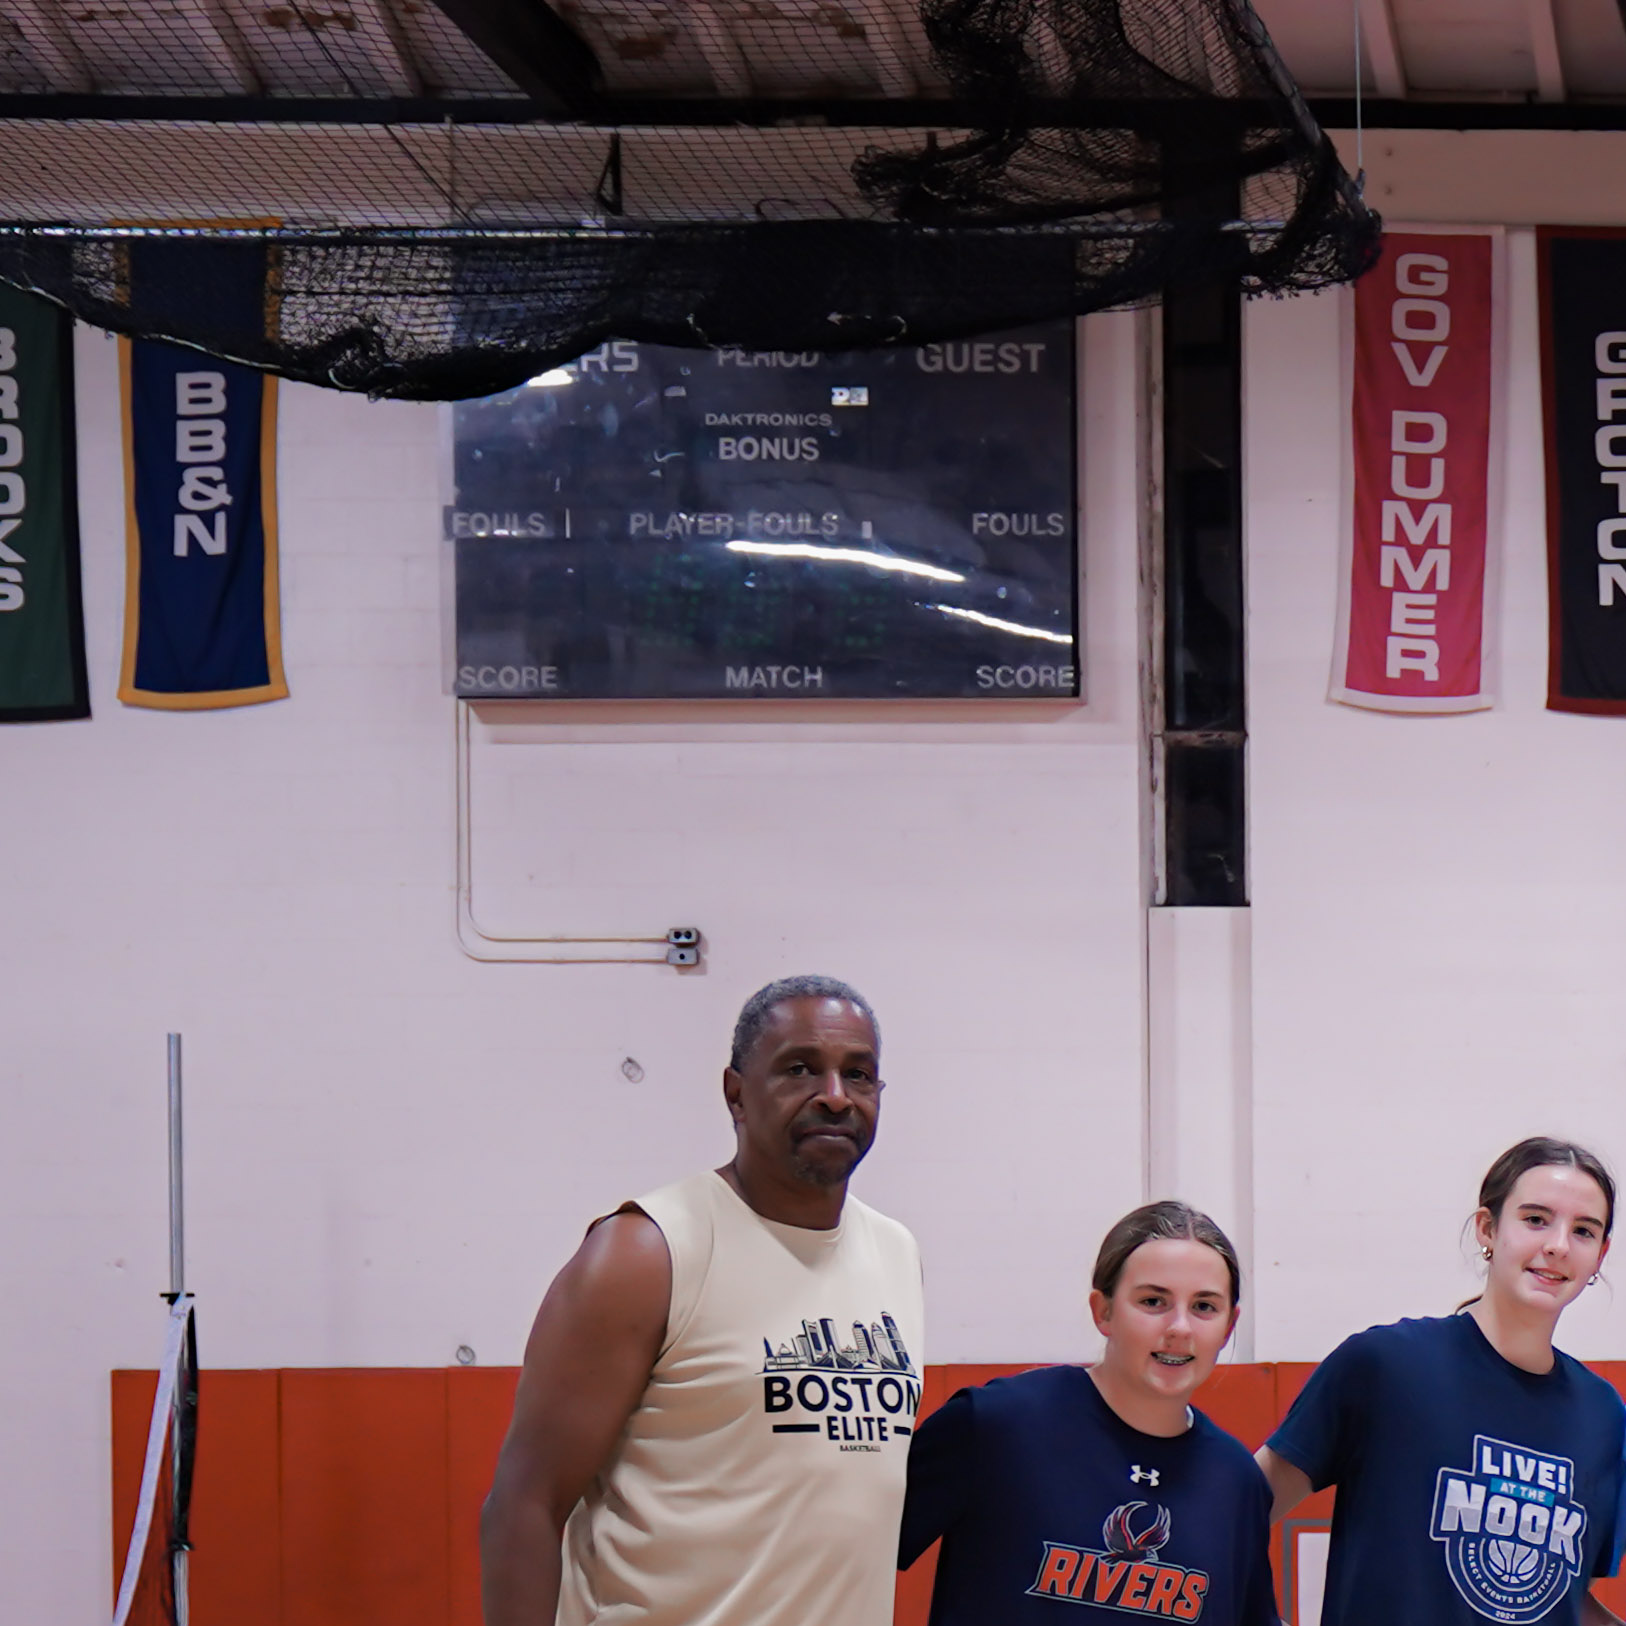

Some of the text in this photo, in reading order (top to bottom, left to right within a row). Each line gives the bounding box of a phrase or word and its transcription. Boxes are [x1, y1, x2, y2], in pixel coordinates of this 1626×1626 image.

[916, 343, 1046, 374] GUEST
[705, 413, 832, 427] DAKTRONICS
[718, 437, 820, 462] BONUS
[172, 370, 233, 558] BB&N
[1380, 252, 1452, 681] GOV DUMMER
[451, 512, 546, 536] FOULS
[972, 512, 1065, 536] FOULS
[458, 665, 558, 688] SCORE
[725, 665, 823, 689] MATCH
[976, 664, 1075, 689] SCORE
[764, 1374, 922, 1417] BOSTON
[826, 1415, 889, 1442] ELITE
[1482, 1445, 1567, 1495] LIVE!
[1500, 1482, 1546, 1502] AT THE
[1440, 1478, 1582, 1565] NOOK
[1036, 1547, 1207, 1620] RIVERS
[1468, 1542, 1482, 1580] SELECT
[1481, 1582, 1513, 1603] EVENTS
